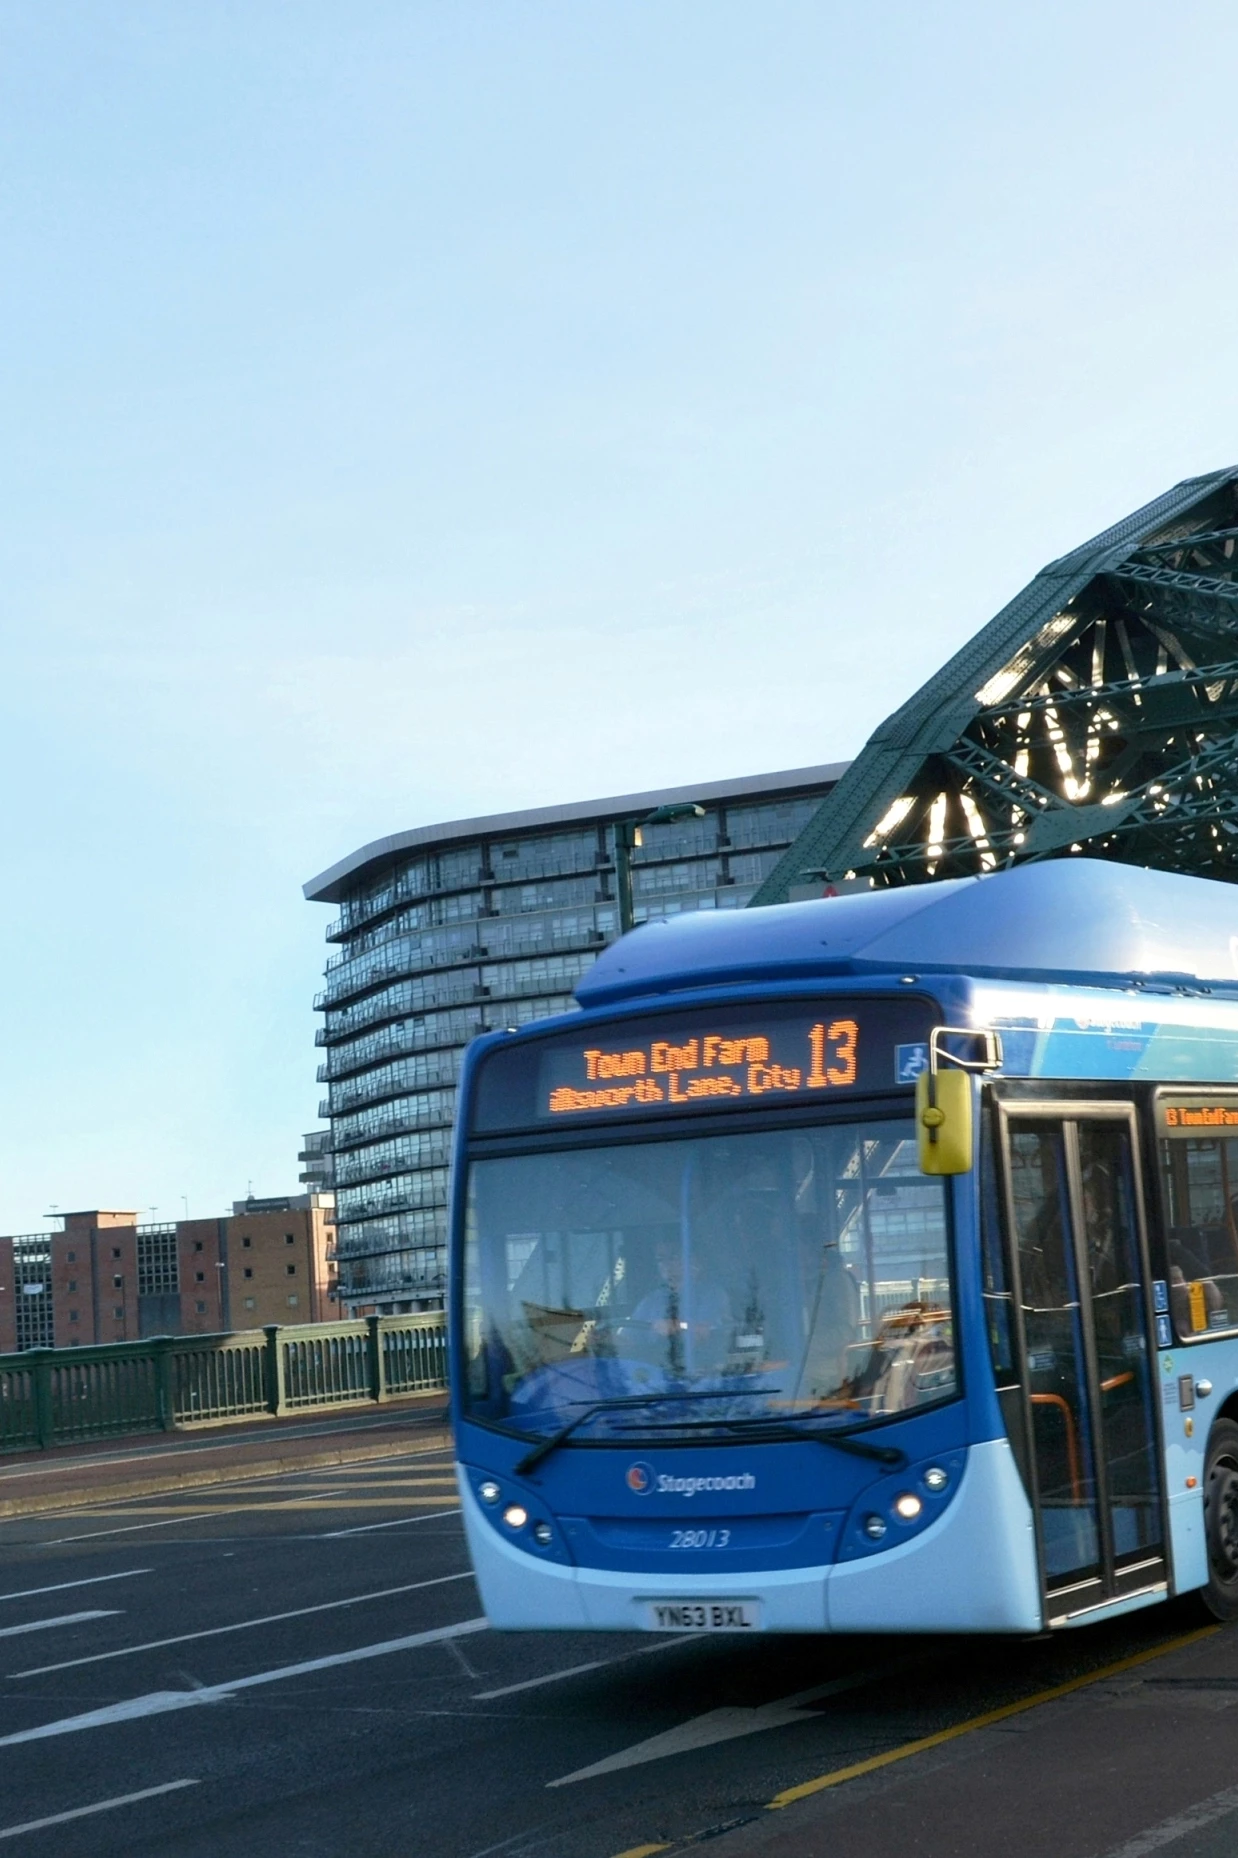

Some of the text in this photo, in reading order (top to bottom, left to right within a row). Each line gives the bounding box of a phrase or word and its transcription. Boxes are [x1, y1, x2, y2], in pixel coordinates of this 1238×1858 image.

[583, 1036, 769, 1080] Town End Farm
[806, 1020, 859, 1088] 13
[747, 1063, 801, 1094] City
[657, 1473, 756, 1498] Stagecoach
[669, 1529, 731, 1549] 28013
[654, 1606, 752, 1628] YN63 BXL
